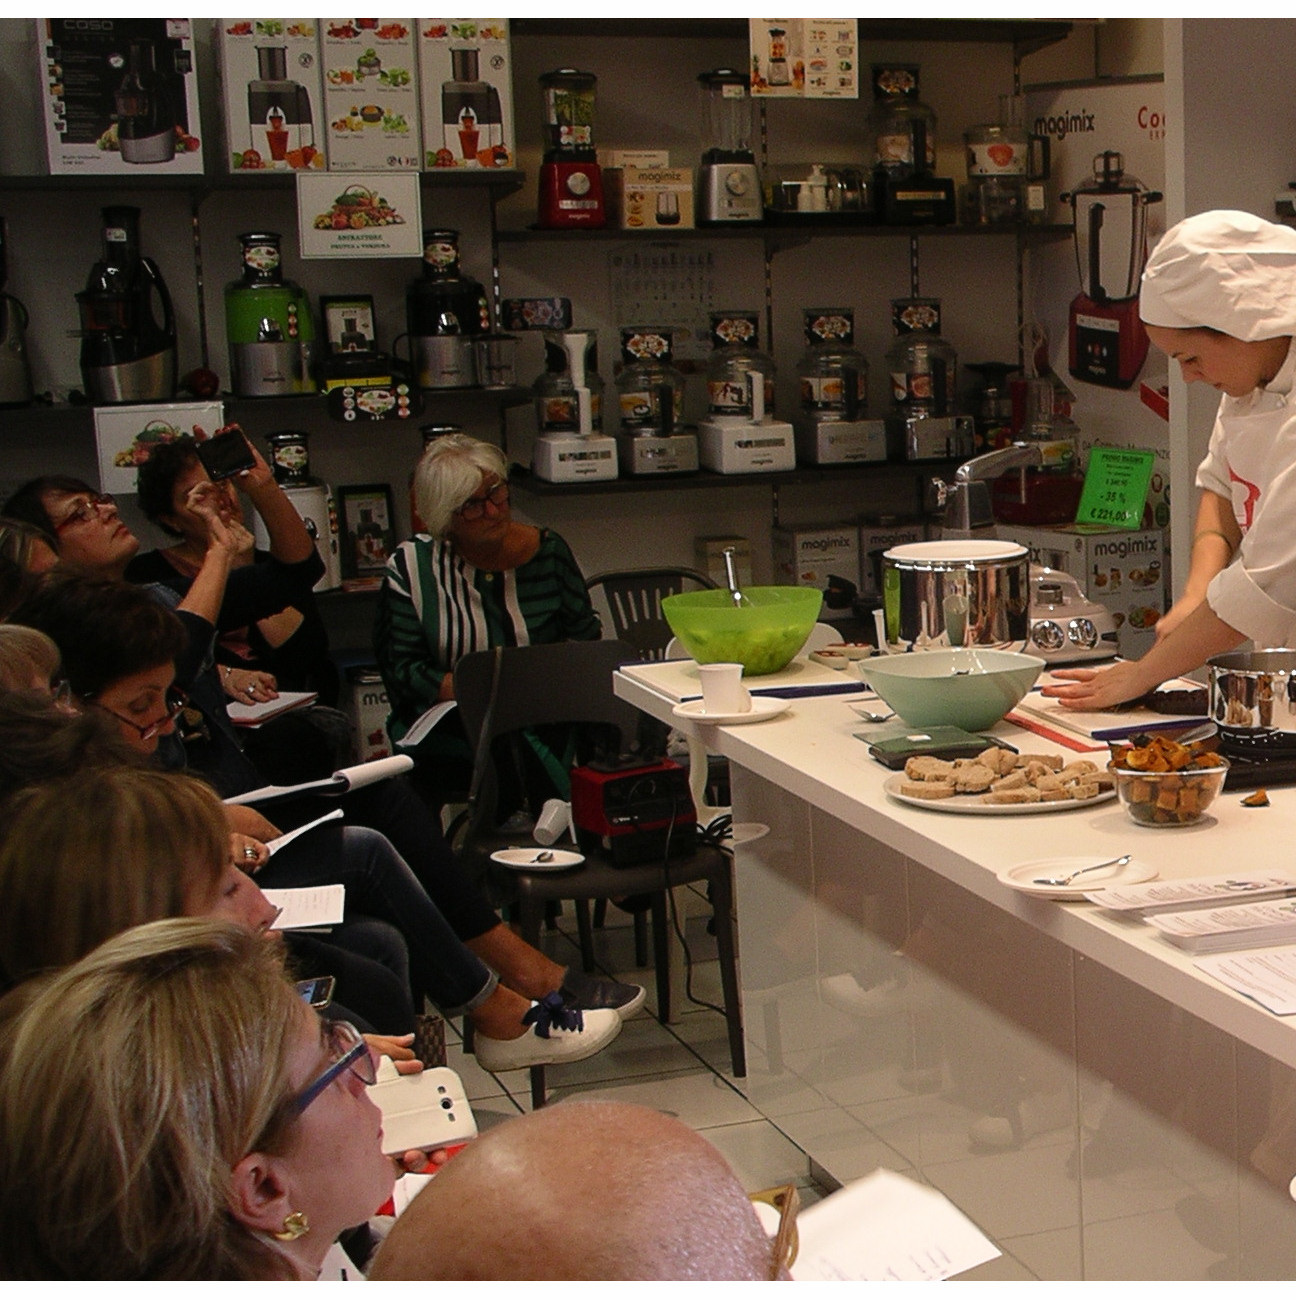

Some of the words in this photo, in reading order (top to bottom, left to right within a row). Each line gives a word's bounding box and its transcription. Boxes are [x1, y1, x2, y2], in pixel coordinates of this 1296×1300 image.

[1033, 108, 1095, 141] magimix
[638, 170, 681, 183] magimix
[801, 536, 850, 551] magimix
[869, 532, 918, 545] magimix
[1094, 535, 1158, 558] magimix
